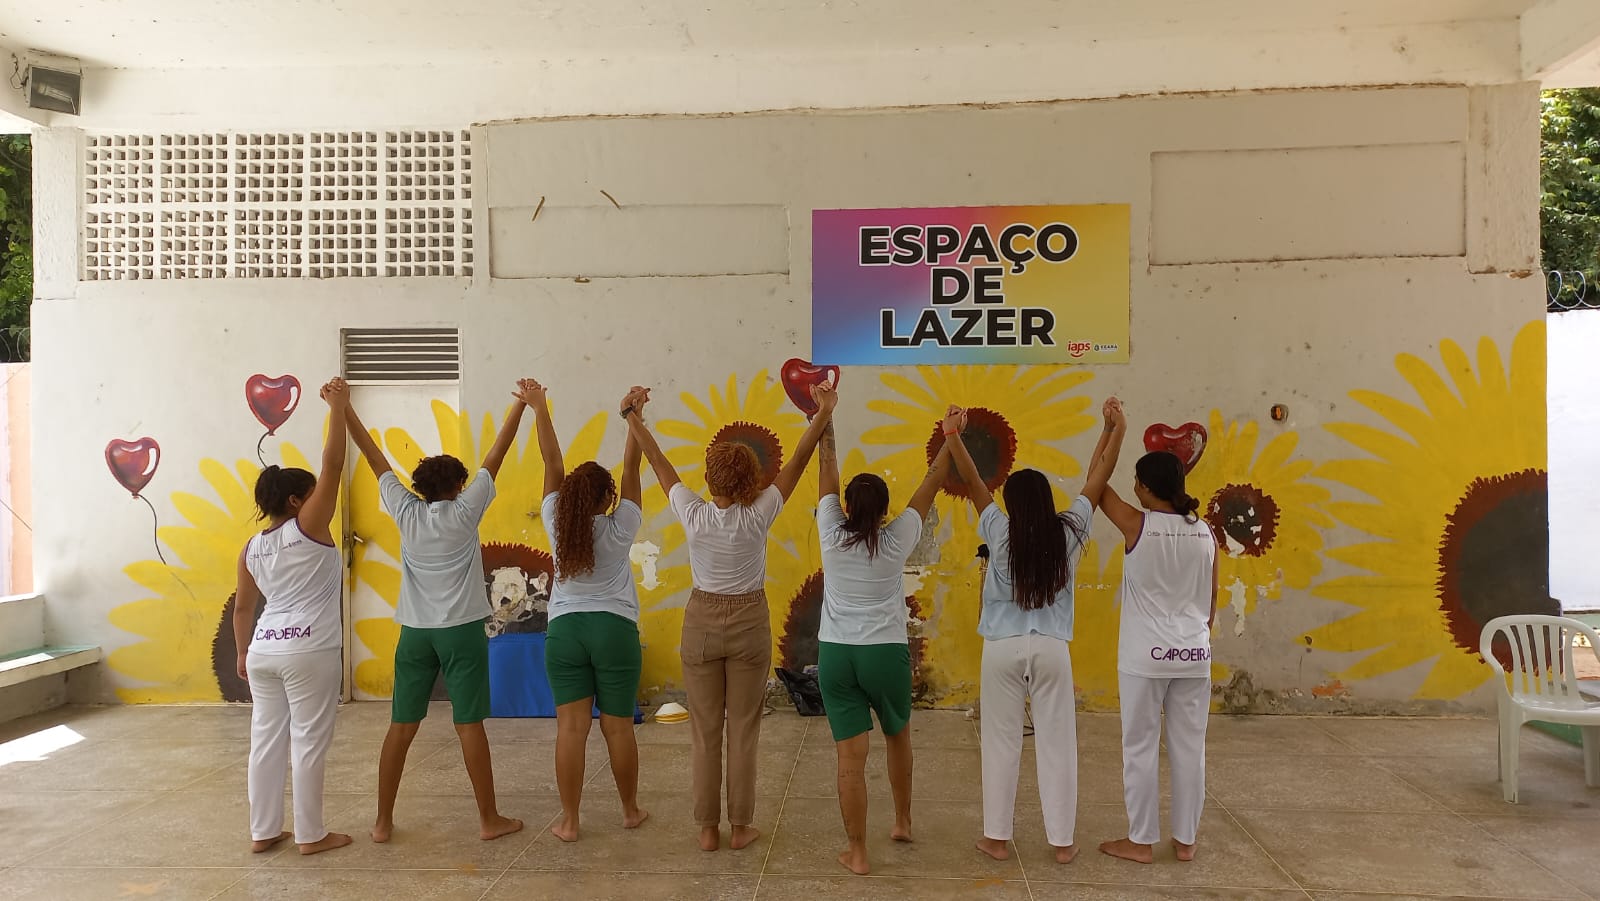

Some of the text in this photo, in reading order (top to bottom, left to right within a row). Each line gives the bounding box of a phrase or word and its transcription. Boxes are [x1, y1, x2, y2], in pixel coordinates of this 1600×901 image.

[860, 223, 1078, 274] ESPAÇO
[931, 267, 1004, 305] DE
[880, 308, 1055, 347] LAZER
[1068, 340, 1091, 354] iaps
[256, 625, 311, 641] CAPOEIRA
